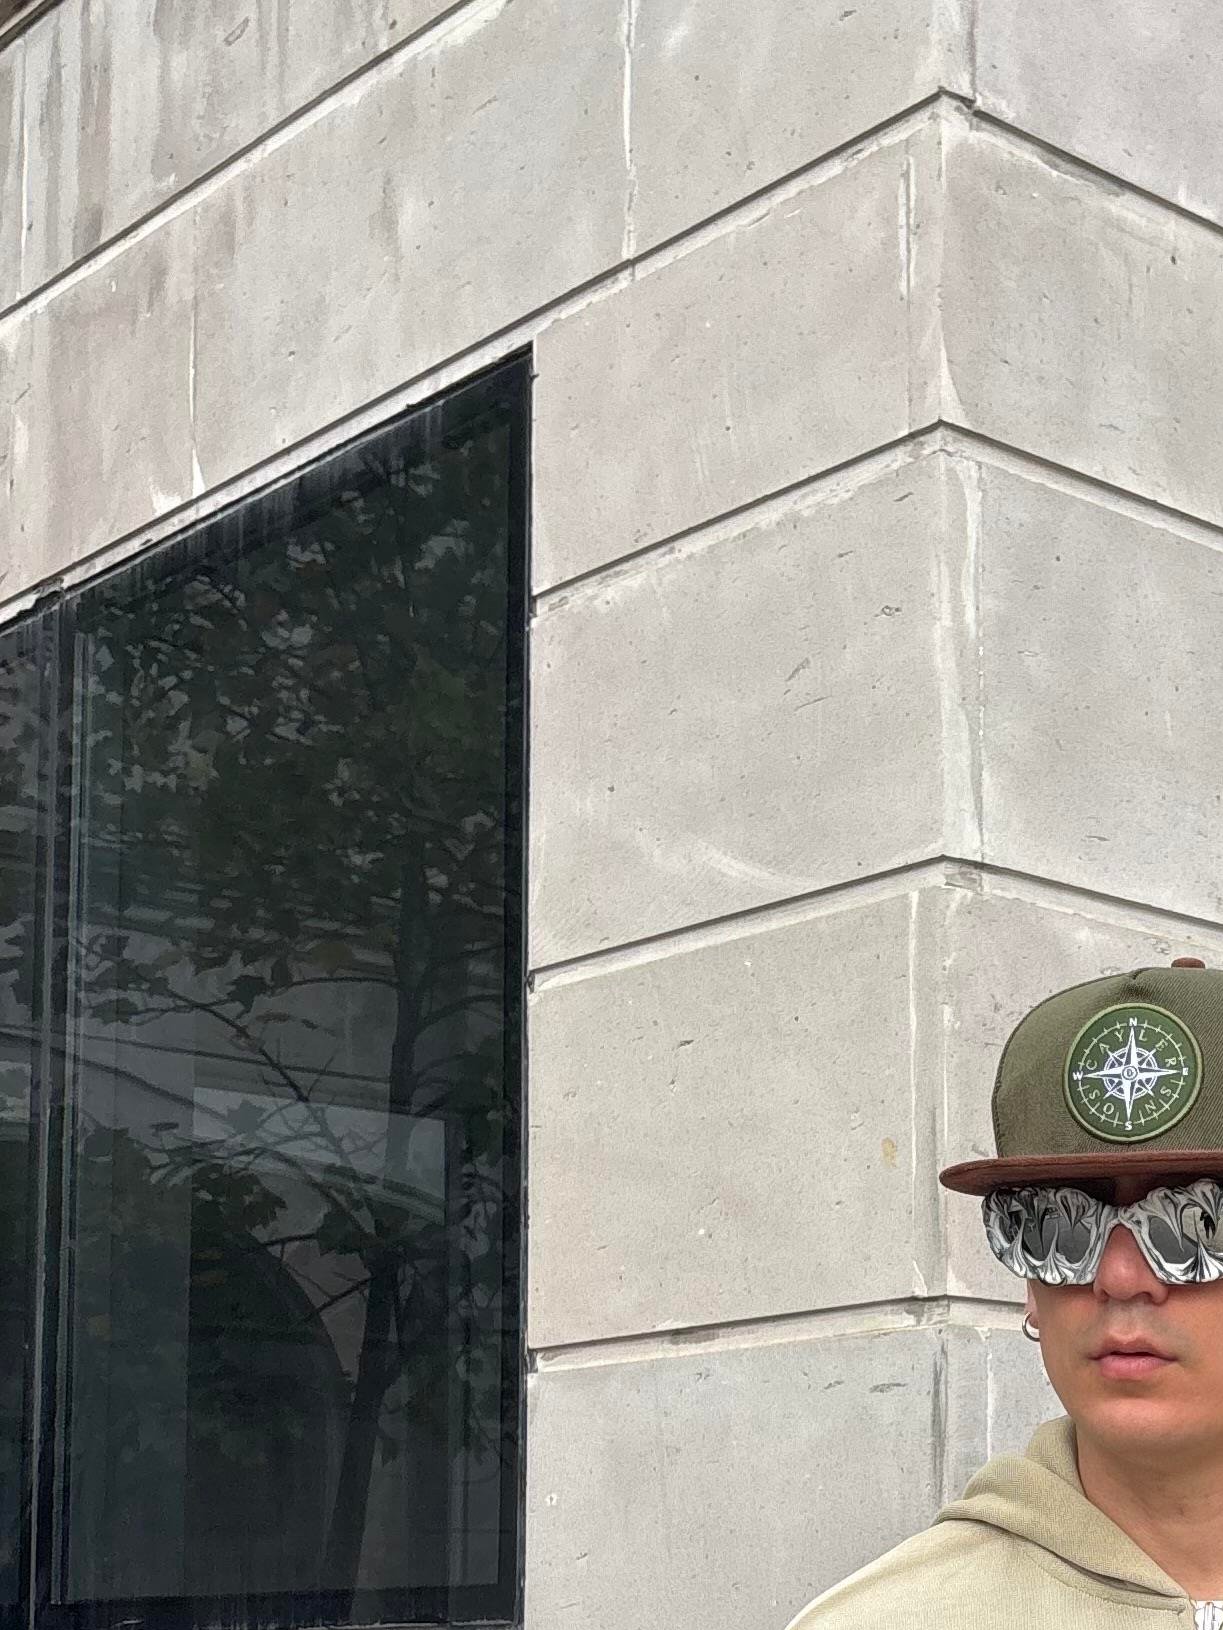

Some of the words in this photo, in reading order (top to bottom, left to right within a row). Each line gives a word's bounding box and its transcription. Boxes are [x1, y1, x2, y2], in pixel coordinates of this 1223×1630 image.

[1129, 1017, 1137, 1026] N
[1086, 1029, 1177, 1071] CAYLER
[1072, 1071, 1083, 1080] W
[1089, 1086, 1172, 1115] SONS
[1124, 1121, 1132, 1131] S
